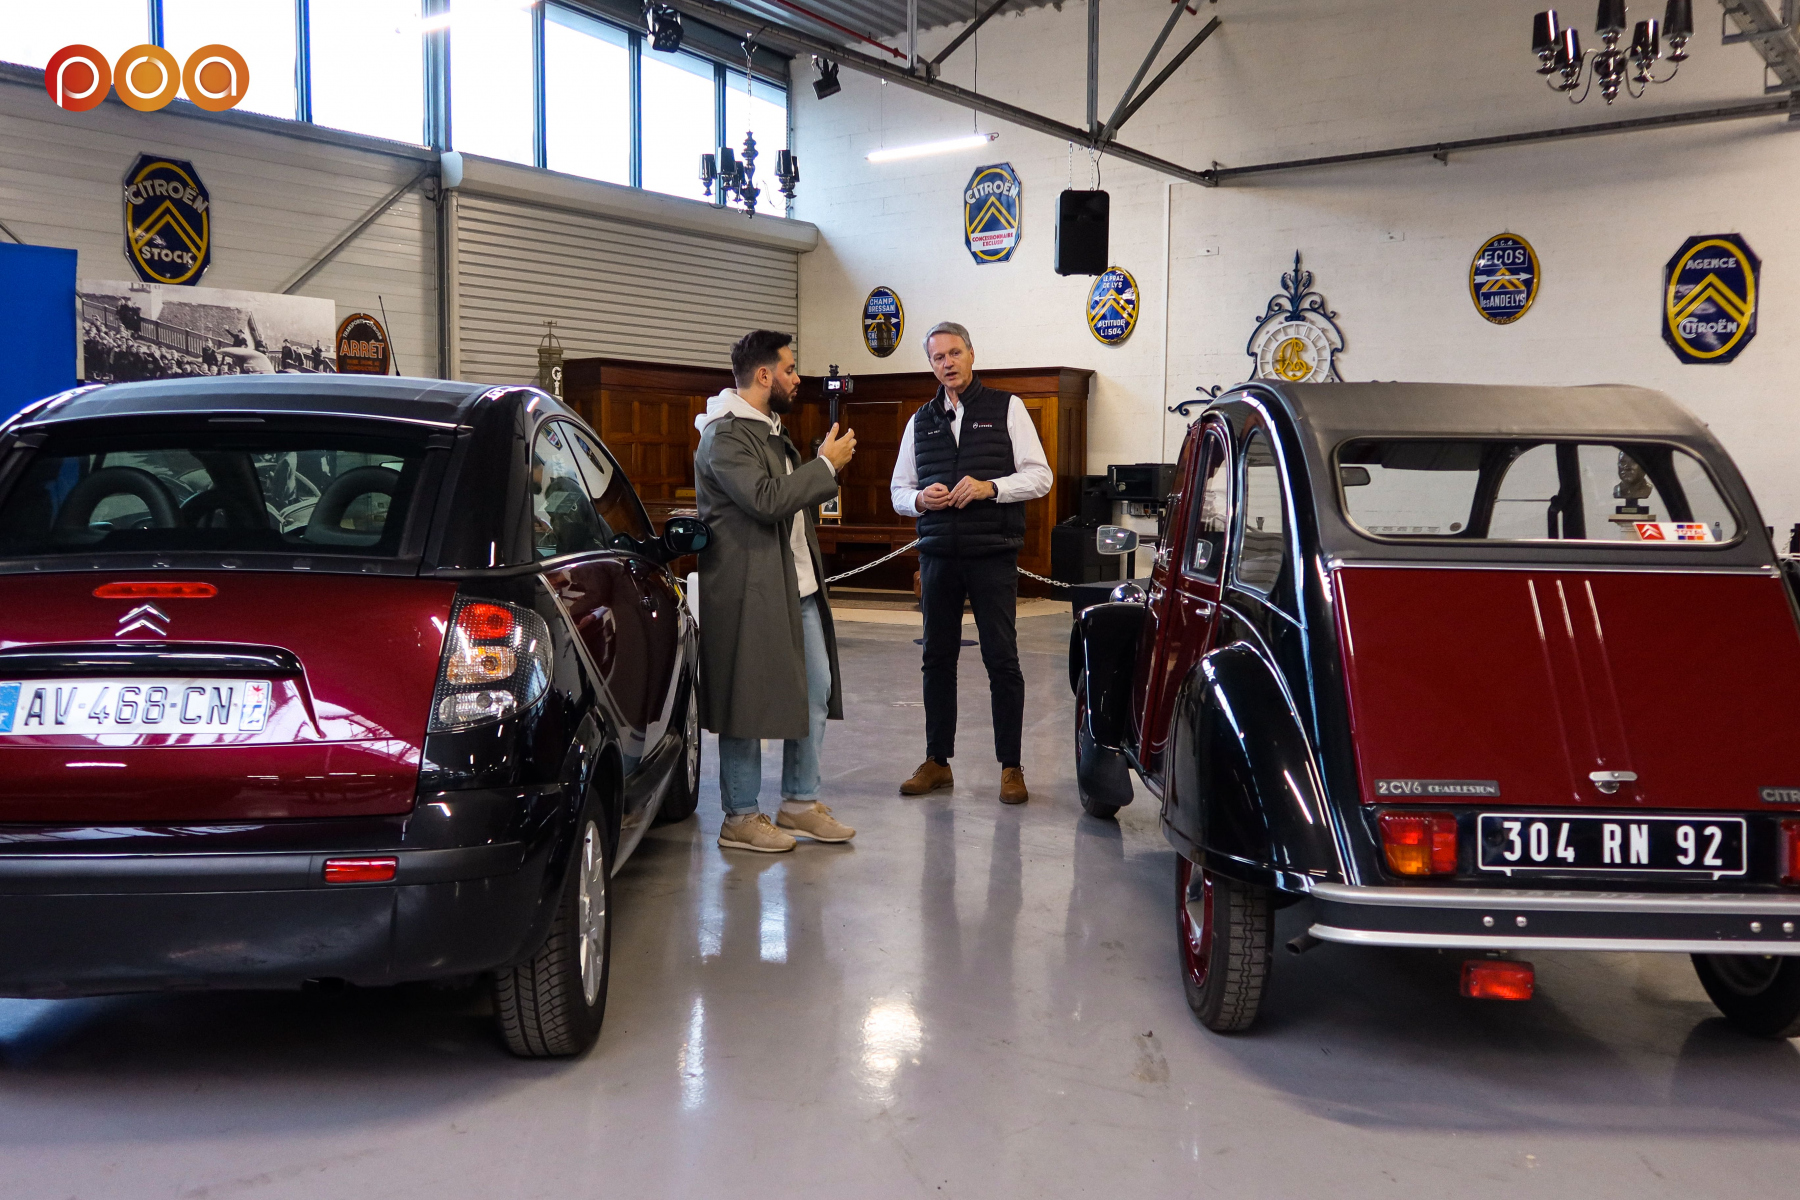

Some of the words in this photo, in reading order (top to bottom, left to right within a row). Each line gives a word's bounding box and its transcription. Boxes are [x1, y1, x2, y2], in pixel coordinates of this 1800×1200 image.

[126, 179, 209, 213] CITROËN
[965, 180, 1019, 204] CITROËN
[141, 246, 195, 264] STOCK
[1484, 249, 1524, 265] ECOS
[1685, 258, 1737, 270] AGENCE
[868, 305, 894, 313] BRESSAN
[869, 298, 894, 306] CHAMP
[1678, 316, 1738, 339] CITROËN
[340, 339, 384, 358] ARRÊT
[24, 686, 234, 726] AV-468-CN
[1379, 781, 1422, 794] 2CV6
[1427, 785, 1496, 793] CHARLESTON
[1502, 821, 1575, 863] 304
[1602, 823, 1649, 865] RN
[1675, 825, 1722, 866] 92
